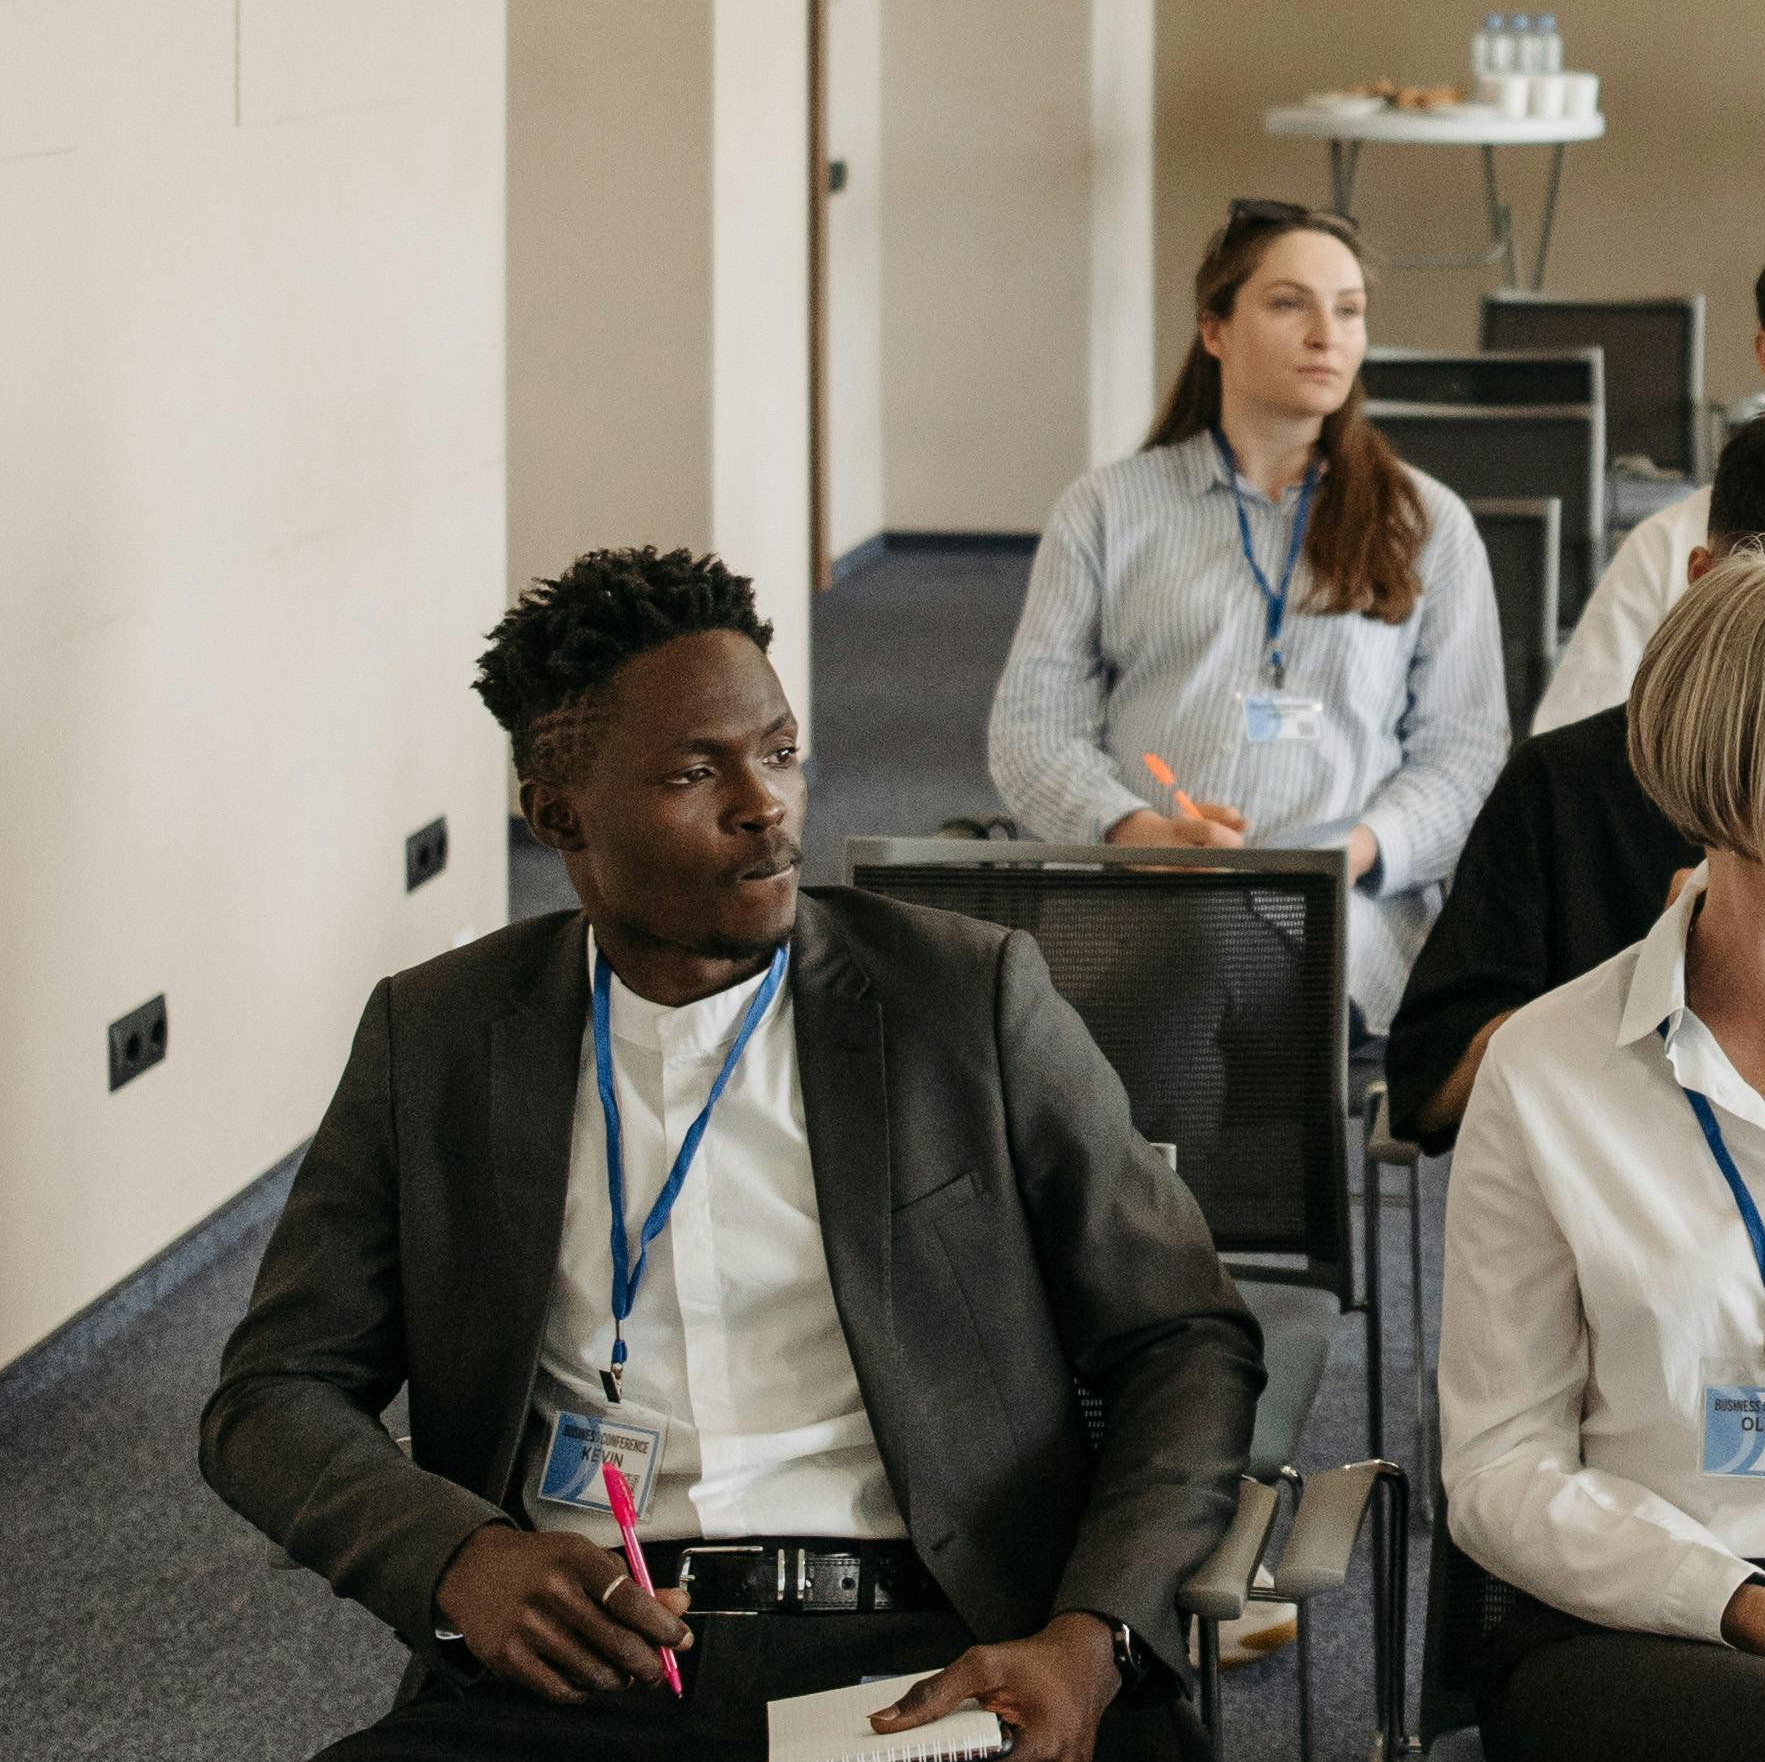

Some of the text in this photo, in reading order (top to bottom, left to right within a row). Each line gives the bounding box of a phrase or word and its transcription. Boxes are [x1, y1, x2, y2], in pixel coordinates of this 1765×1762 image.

[1714, 1397, 1760, 1412] BUSINESS
[601, 1433, 649, 1454] CONFERENCE
[580, 1445, 624, 1468] KEVIN
